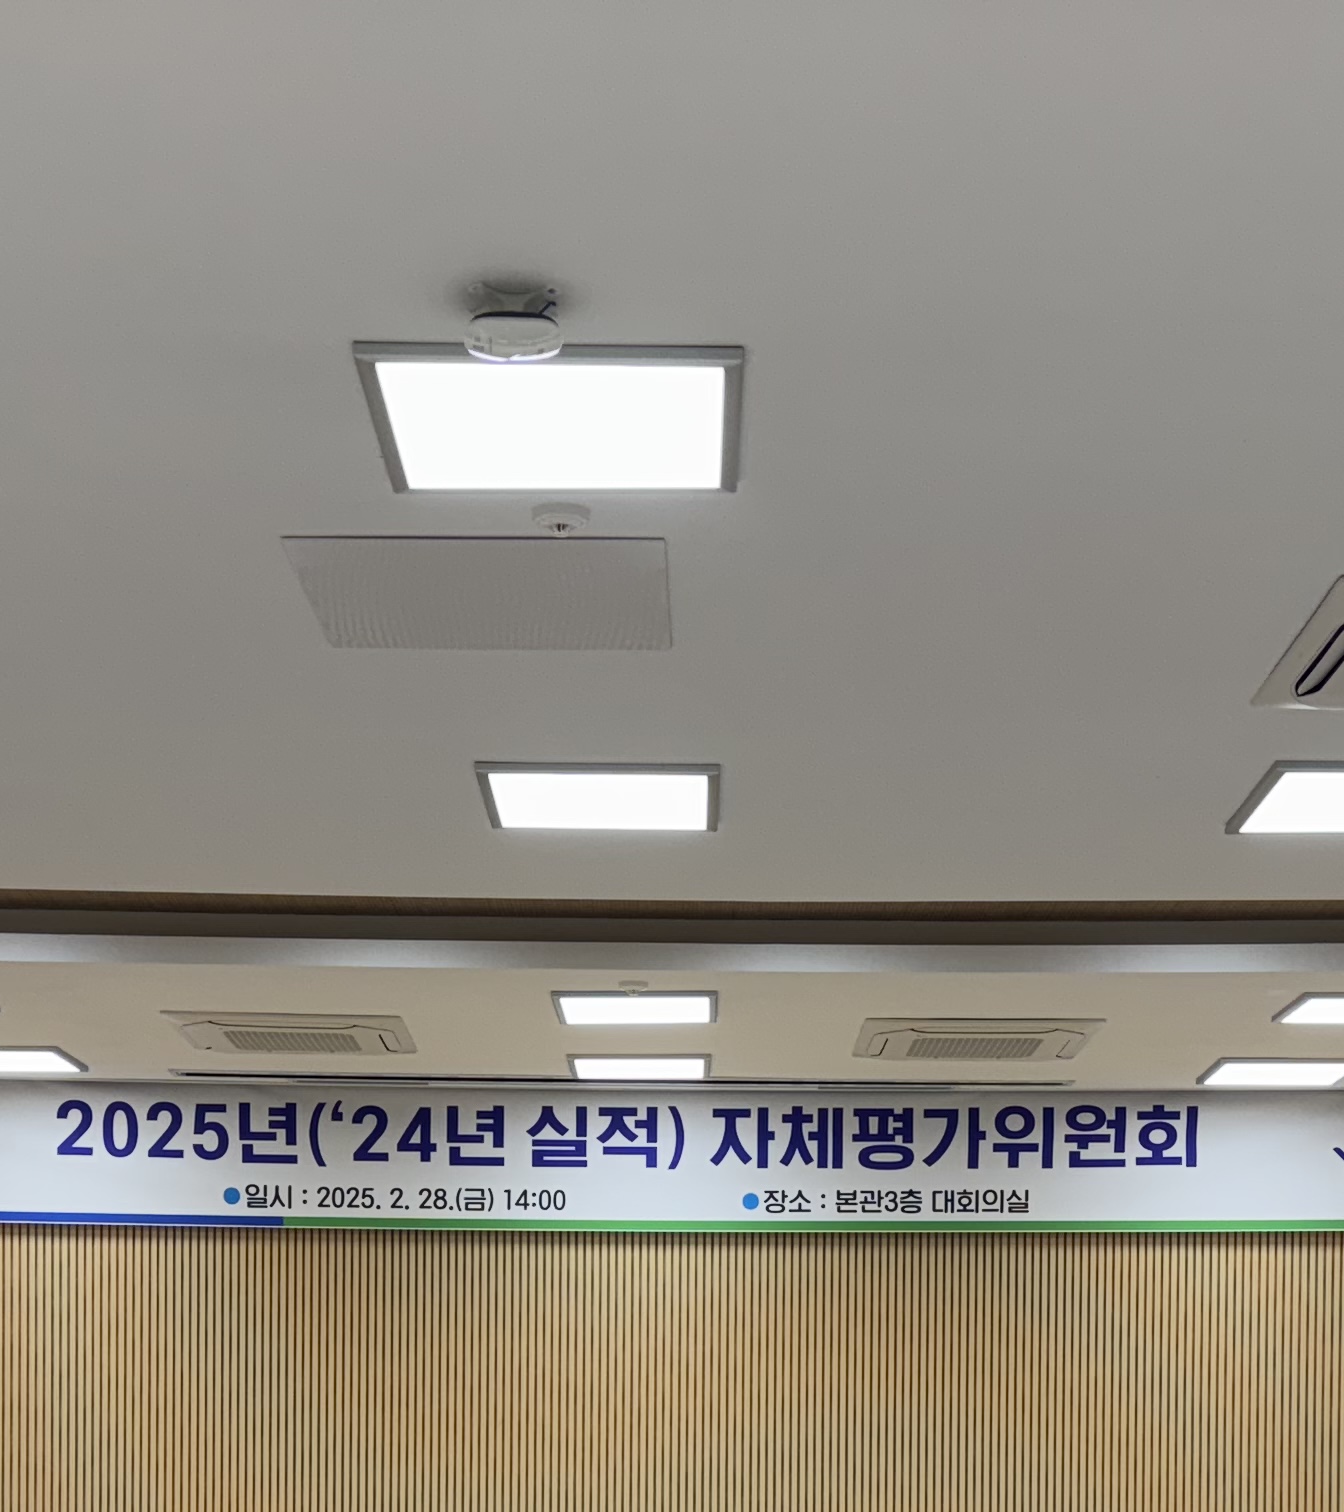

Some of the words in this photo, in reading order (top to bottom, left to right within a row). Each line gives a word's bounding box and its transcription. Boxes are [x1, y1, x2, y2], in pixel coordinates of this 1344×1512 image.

[526, 1104, 685, 1169] 실적)
[709, 1104, 1199, 1171] 자체평가위원회
[244, 1183, 293, 1210] 일시
[316, 1187, 382, 1210] 2025.
[389, 1187, 410, 1211] 2.
[418, 1187, 494, 1212] 28.(금)
[503, 1189, 566, 1211] 14:00
[763, 1189, 812, 1214] 장소
[835, 1188, 923, 1214] 본관3층
[931, 1188, 1030, 1214] 대회의실
